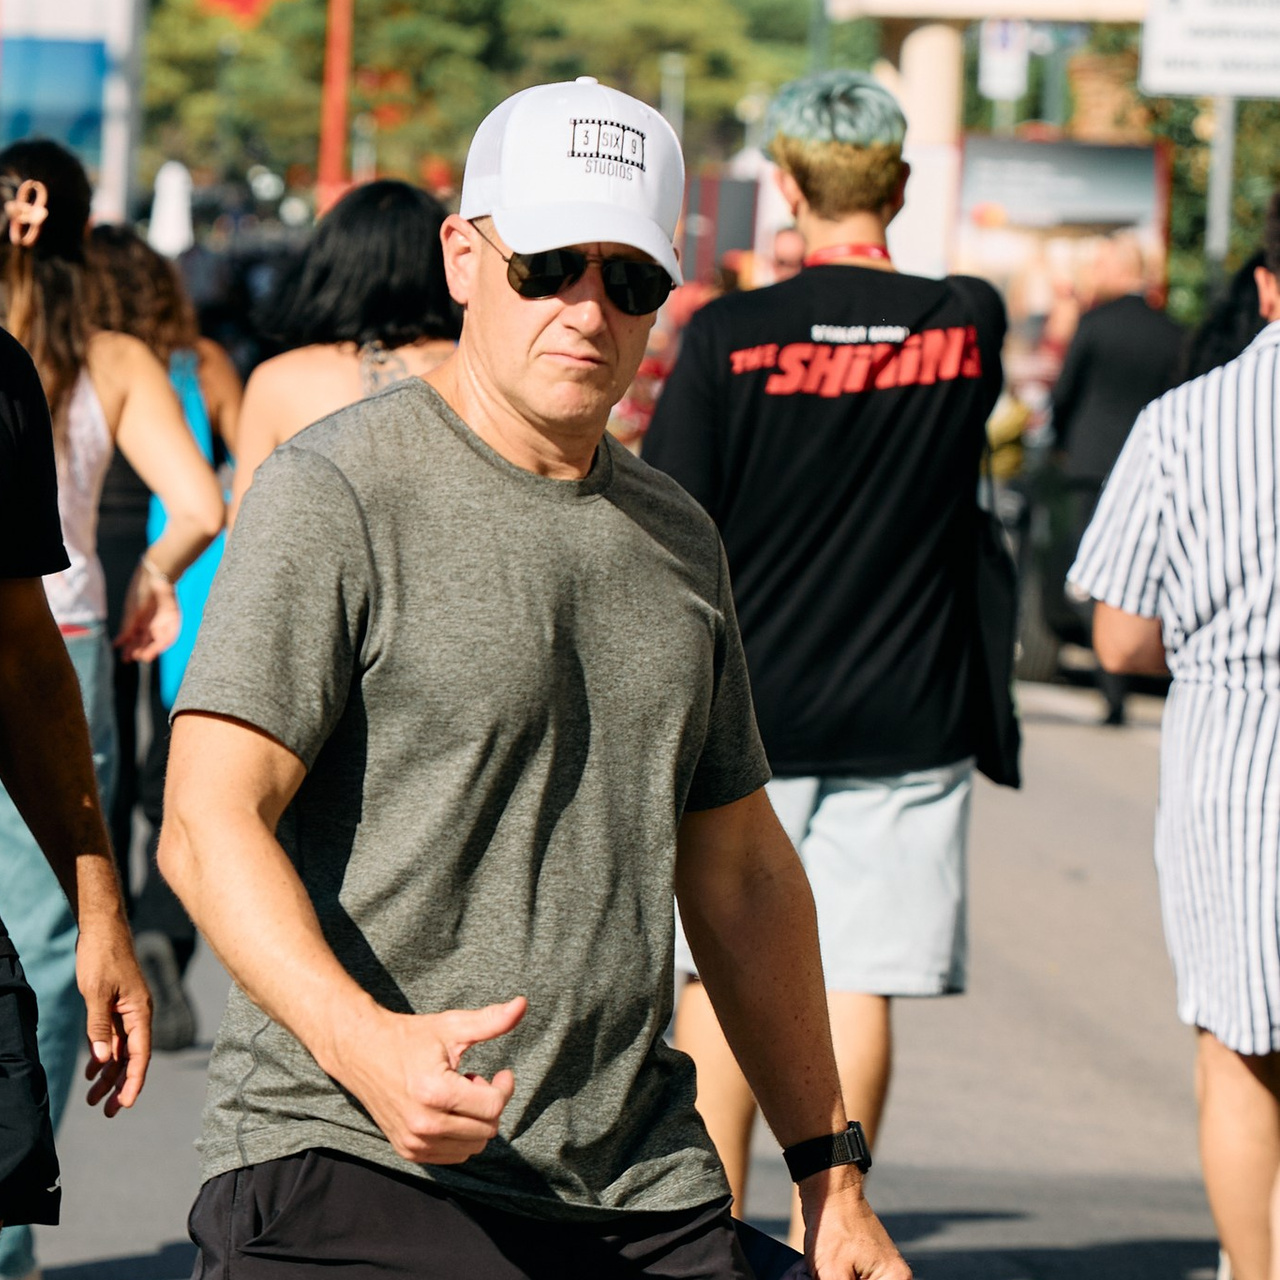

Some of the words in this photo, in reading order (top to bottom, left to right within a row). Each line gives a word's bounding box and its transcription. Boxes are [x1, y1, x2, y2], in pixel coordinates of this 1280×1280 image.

[583, 130, 590, 145] 3
[601, 131, 621, 149] SIX
[631, 139, 637, 154] 9
[584, 158, 633, 181] STUDIOS
